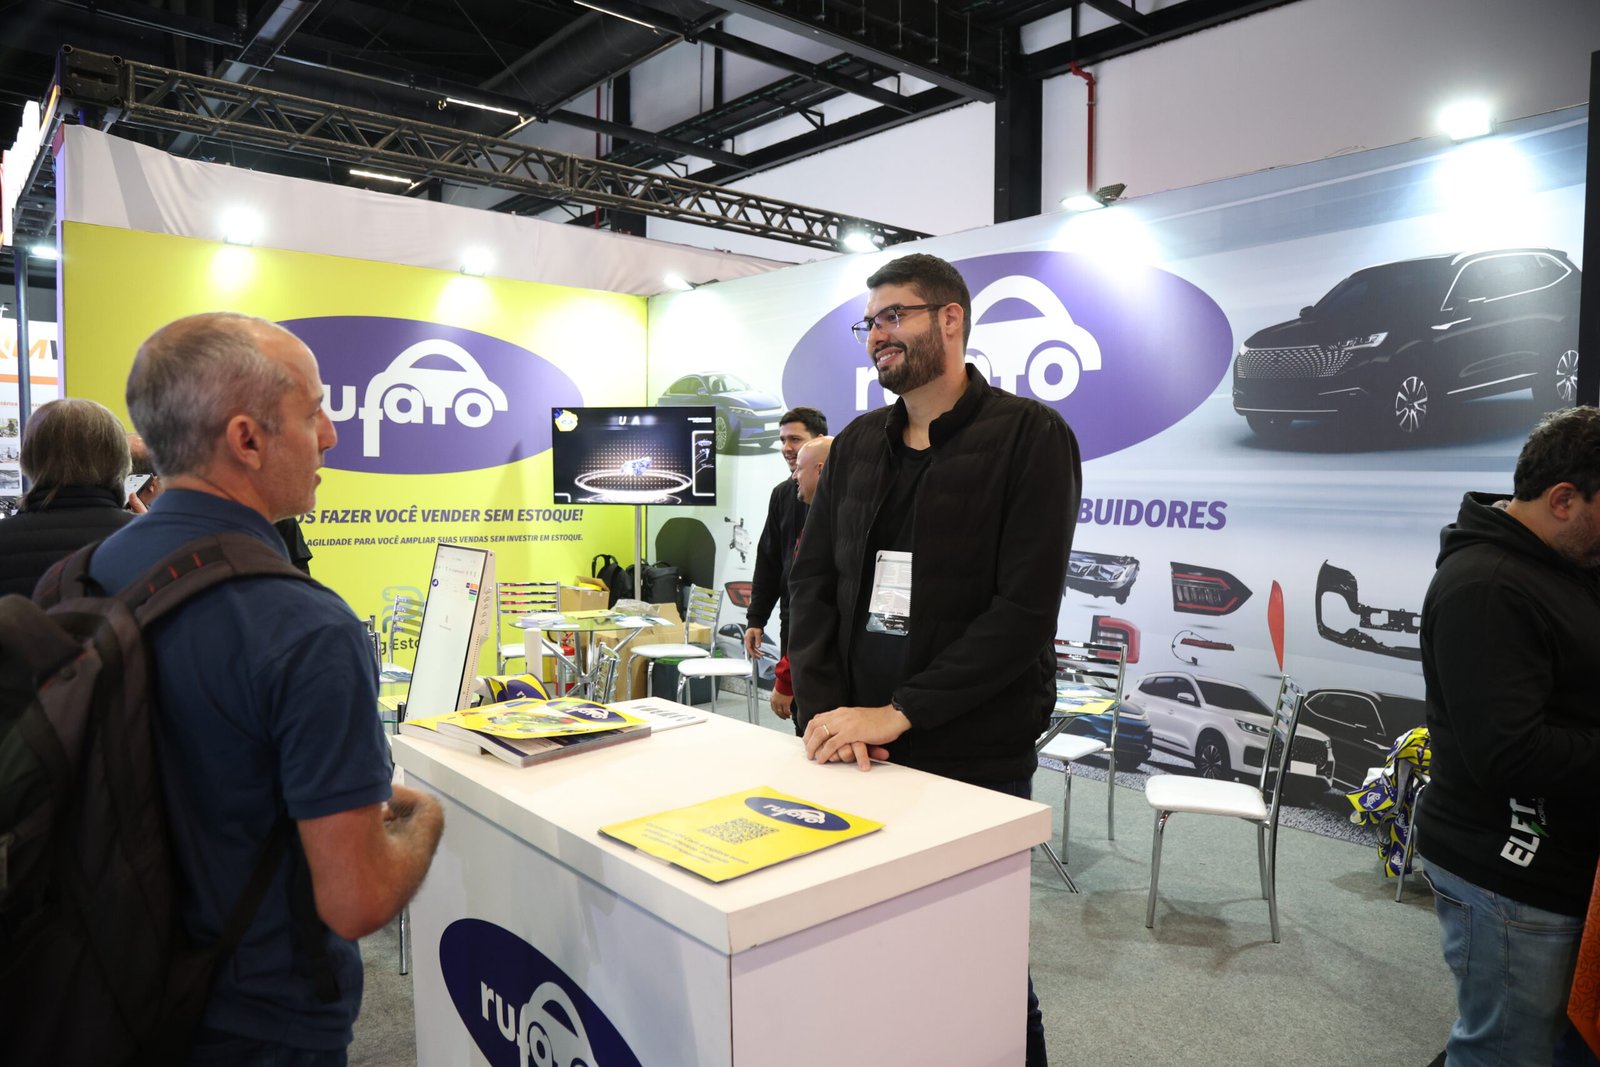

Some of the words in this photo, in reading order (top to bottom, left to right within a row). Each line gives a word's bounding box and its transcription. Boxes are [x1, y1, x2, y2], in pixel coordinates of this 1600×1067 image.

[322, 340, 508, 457] ufato
[320, 509, 371, 523] FAZER
[376, 505, 418, 523] VOCÊ
[421, 509, 480, 522] VENDER
[484, 509, 514, 522] SEM
[517, 509, 584, 523] ESTOQUE!
[1076, 498, 1228, 531] BUIDORES
[306, 537, 352, 546] AGILIDADE
[354, 537, 376, 545] PARA
[378, 535, 399, 545] VOCÊ
[400, 536, 436, 544] AMPLIAR
[507, 534, 539, 542] INVESTIR
